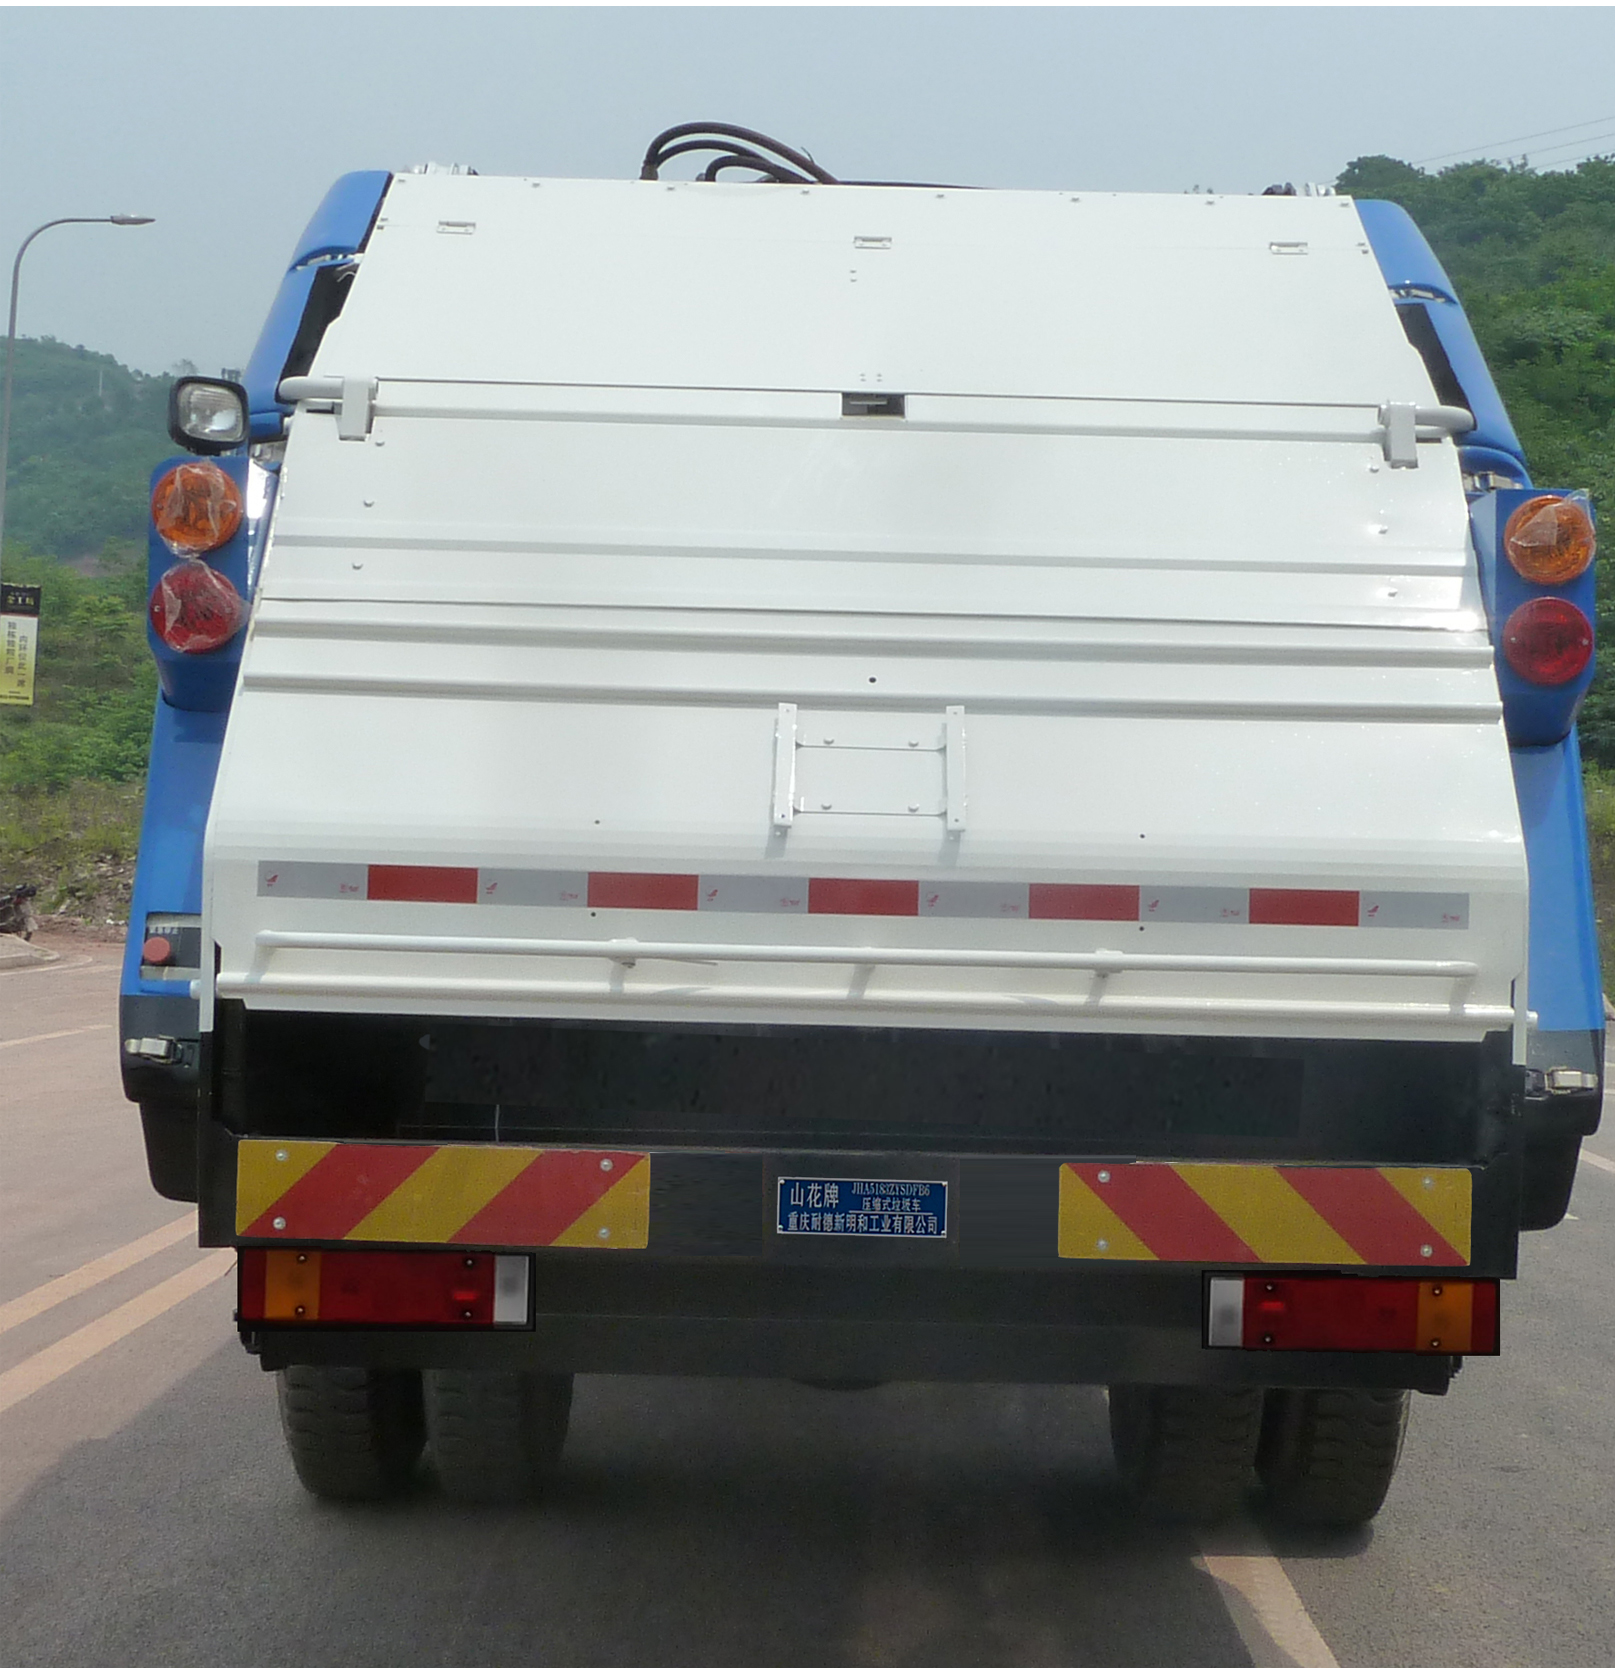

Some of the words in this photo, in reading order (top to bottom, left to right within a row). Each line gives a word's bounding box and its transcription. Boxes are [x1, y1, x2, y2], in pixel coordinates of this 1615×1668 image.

[790, 1182, 839, 1209] 山花牌
[861, 1197, 922, 1213] 压缩式垃圾车
[787, 1211, 938, 1235] 重庆耐德新明和工业有限公司
